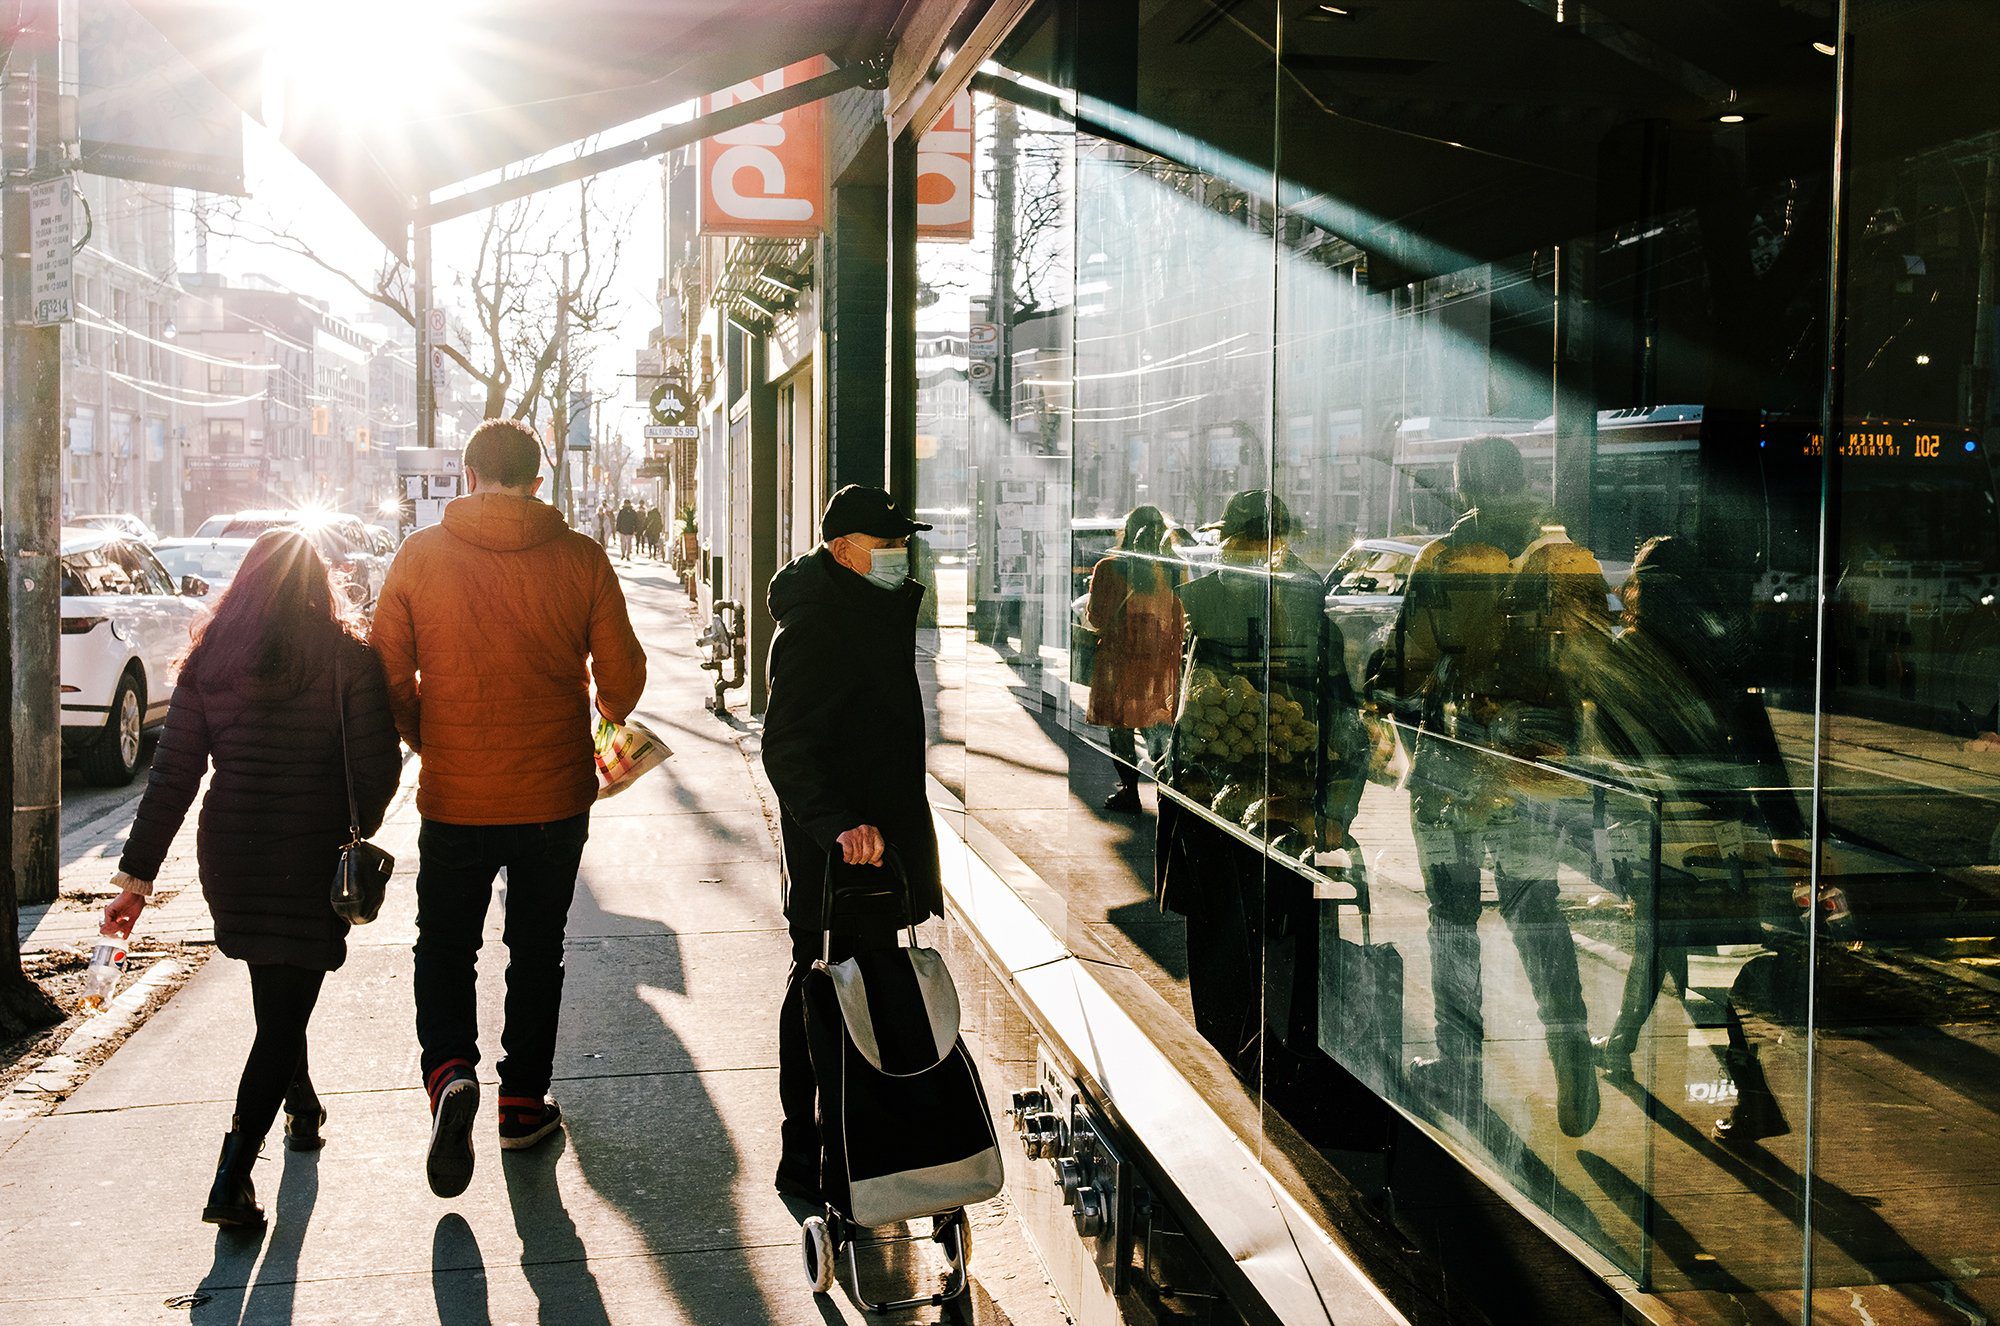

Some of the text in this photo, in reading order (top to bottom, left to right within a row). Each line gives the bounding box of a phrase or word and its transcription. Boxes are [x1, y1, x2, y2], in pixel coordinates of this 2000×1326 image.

[41, 217, 51, 226] MON
[47, 250, 55, 258] SAT
[47, 272, 55, 281] SUN
[675, 427, 695, 436] $5.95
